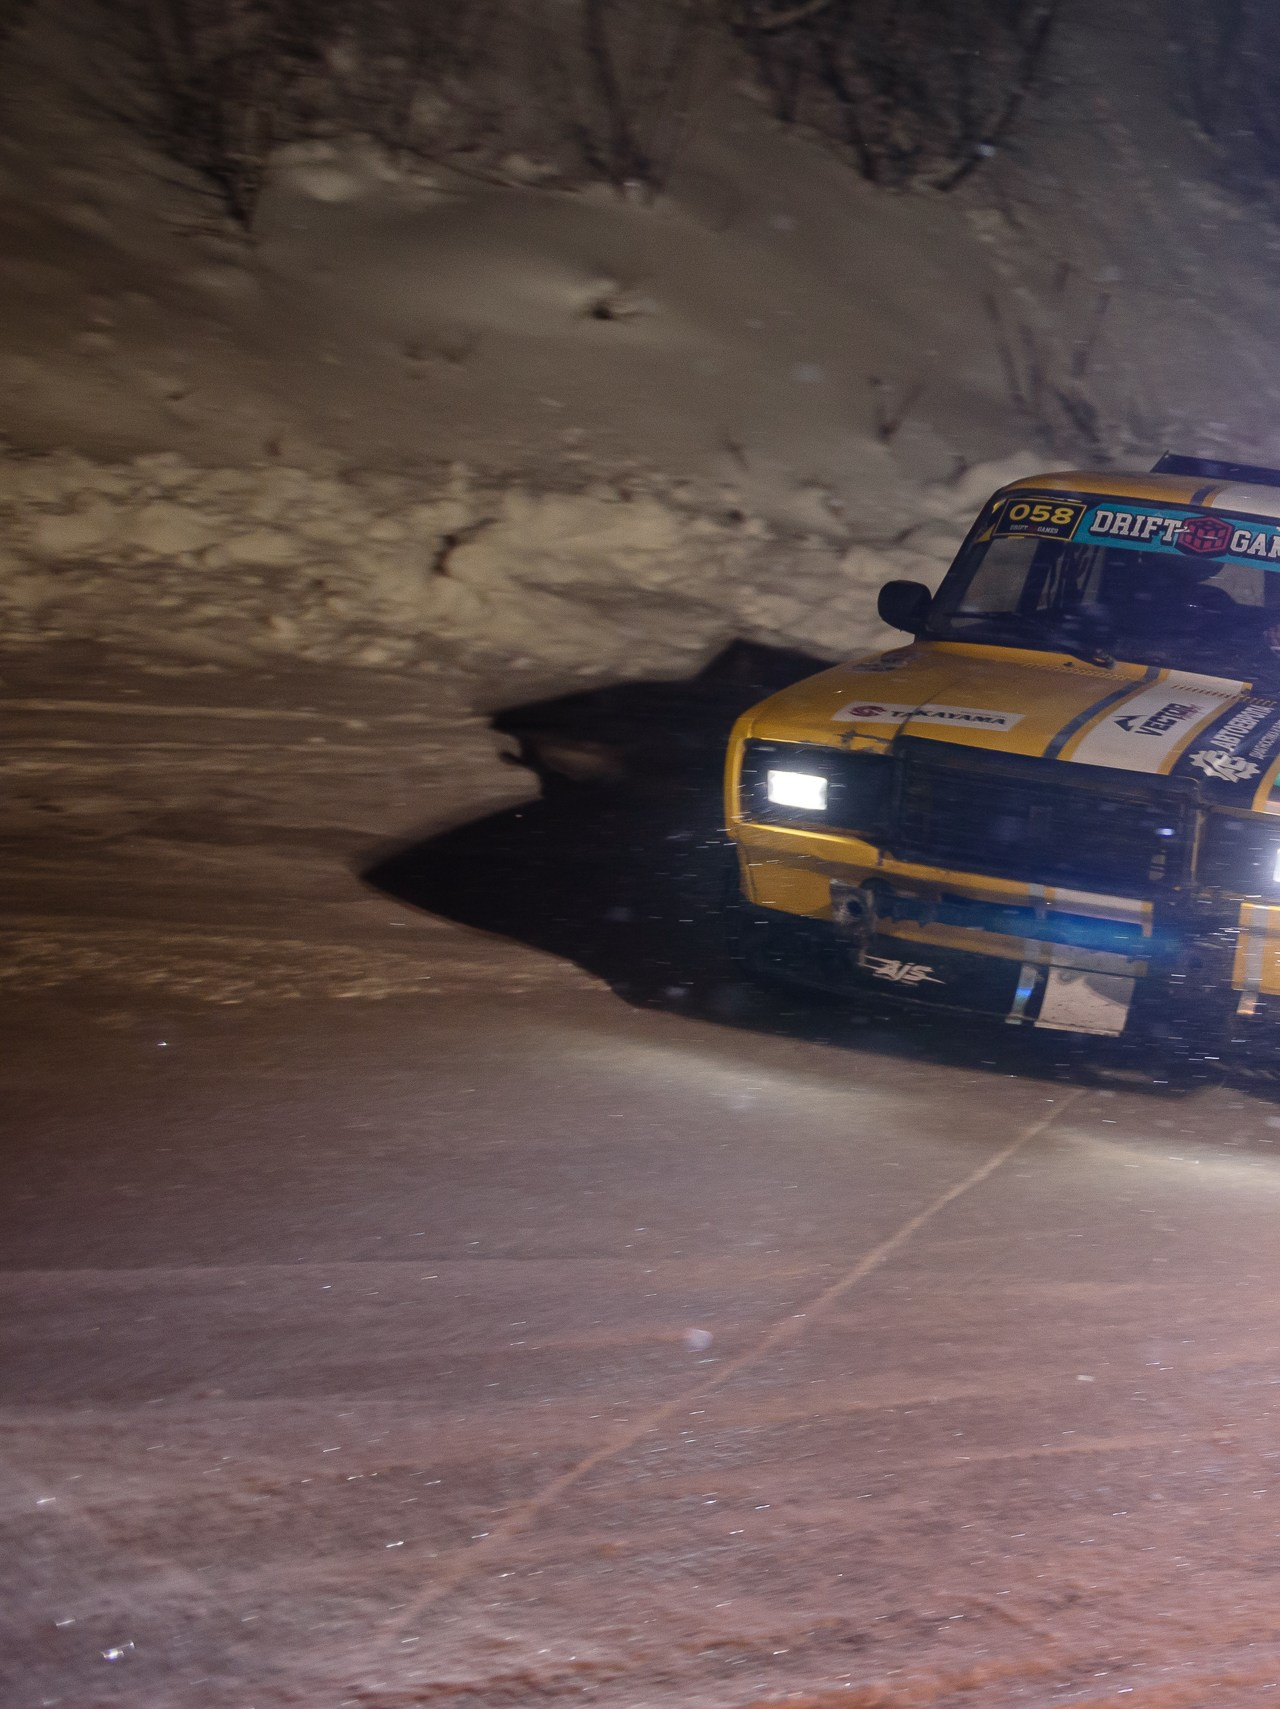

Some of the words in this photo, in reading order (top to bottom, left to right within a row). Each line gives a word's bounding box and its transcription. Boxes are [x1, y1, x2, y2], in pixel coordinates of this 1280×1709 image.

[1009, 504, 1074, 524] 058
[1089, 510, 1183, 542] DRIFT
[891, 709, 1006, 725] TAKAYAMA
